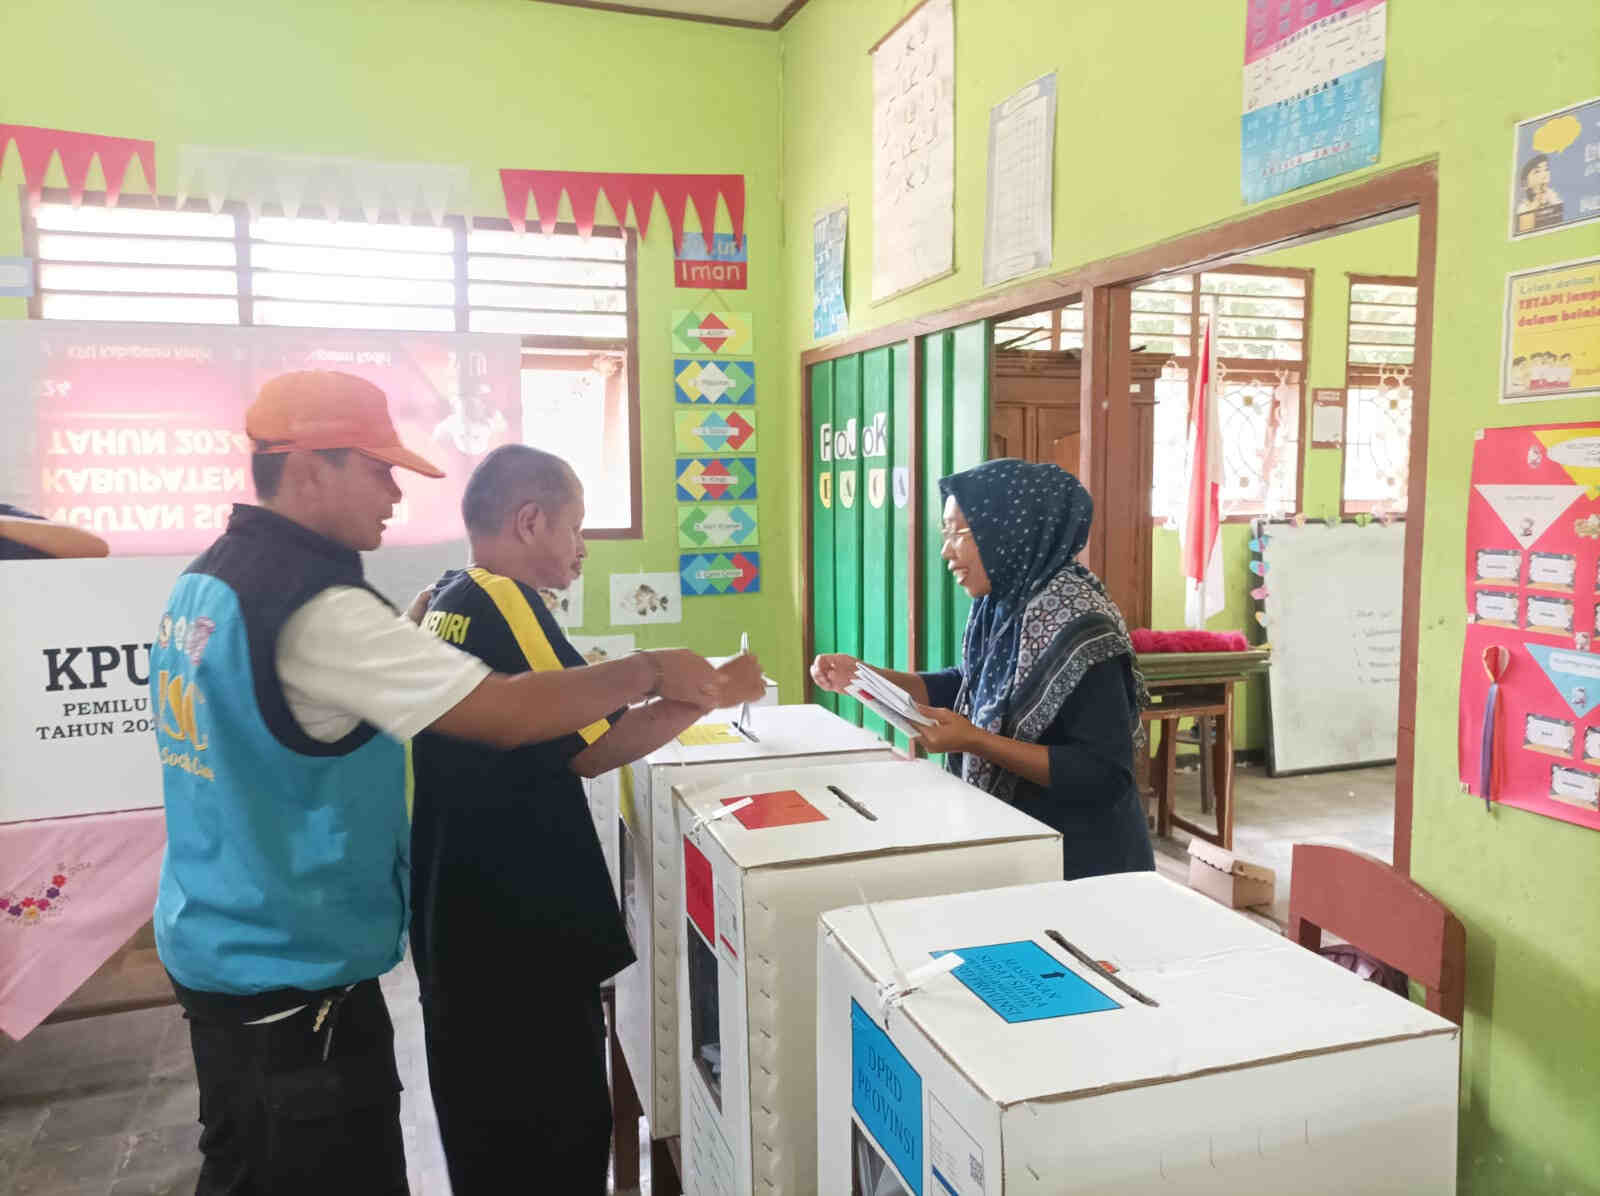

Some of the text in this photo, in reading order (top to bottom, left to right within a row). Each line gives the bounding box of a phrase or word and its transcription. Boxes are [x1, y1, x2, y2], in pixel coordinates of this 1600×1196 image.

[43, 642, 152, 692] KPU
[35, 720, 115, 741] TAHUN
[62, 697, 149, 718] PEMILU
[867, 1045, 903, 1103] DPRD
[857, 1066, 915, 1161] PROVINSI
